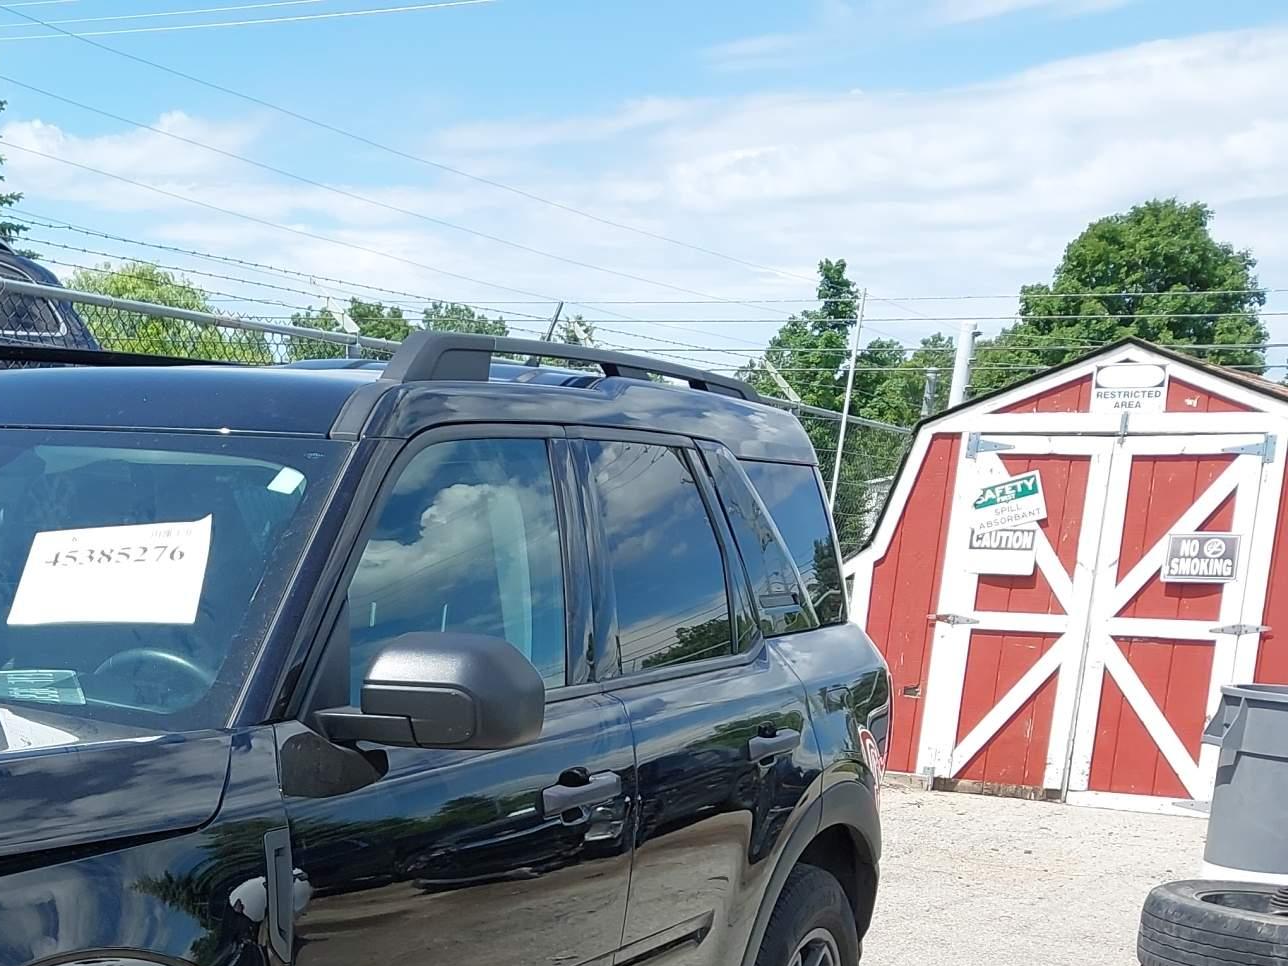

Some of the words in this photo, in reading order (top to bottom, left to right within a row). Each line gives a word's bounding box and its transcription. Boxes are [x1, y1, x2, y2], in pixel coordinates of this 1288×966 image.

[1096, 390, 1162, 399] RESTRICTED
[1114, 400, 1141, 409] AREA
[974, 476, 1036, 504] SAFETY
[979, 507, 1041, 530] ABSORBANT
[994, 503, 1022, 516] SPILL
[972, 530, 1034, 550] CAUTION
[1179, 539, 1200, 558] NO
[44, 545, 186, 567] 45385276
[1169, 557, 1233, 577] SMOKING
